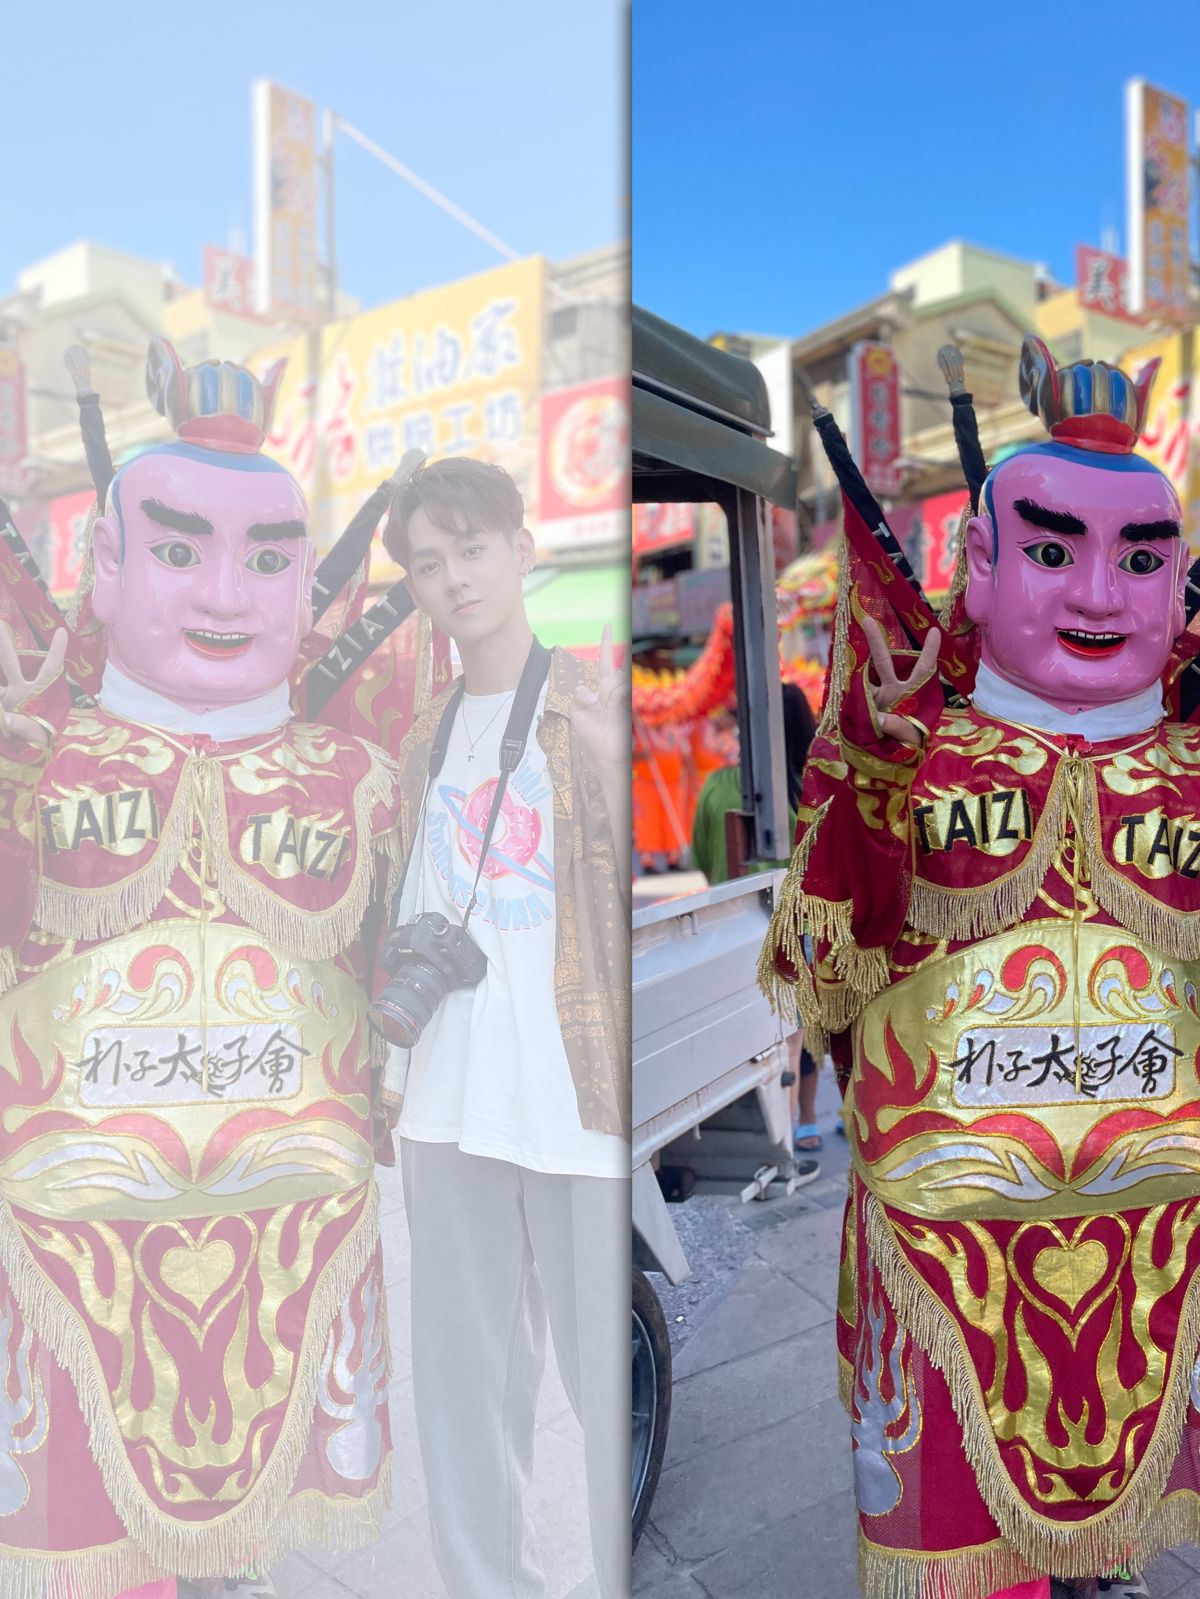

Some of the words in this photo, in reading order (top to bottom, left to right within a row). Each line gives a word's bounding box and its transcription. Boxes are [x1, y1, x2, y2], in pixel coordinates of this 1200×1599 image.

[40, 788, 159, 855] TAIZI
[248, 815, 351, 883] TAIZI
[913, 788, 1032, 855] TAIZI
